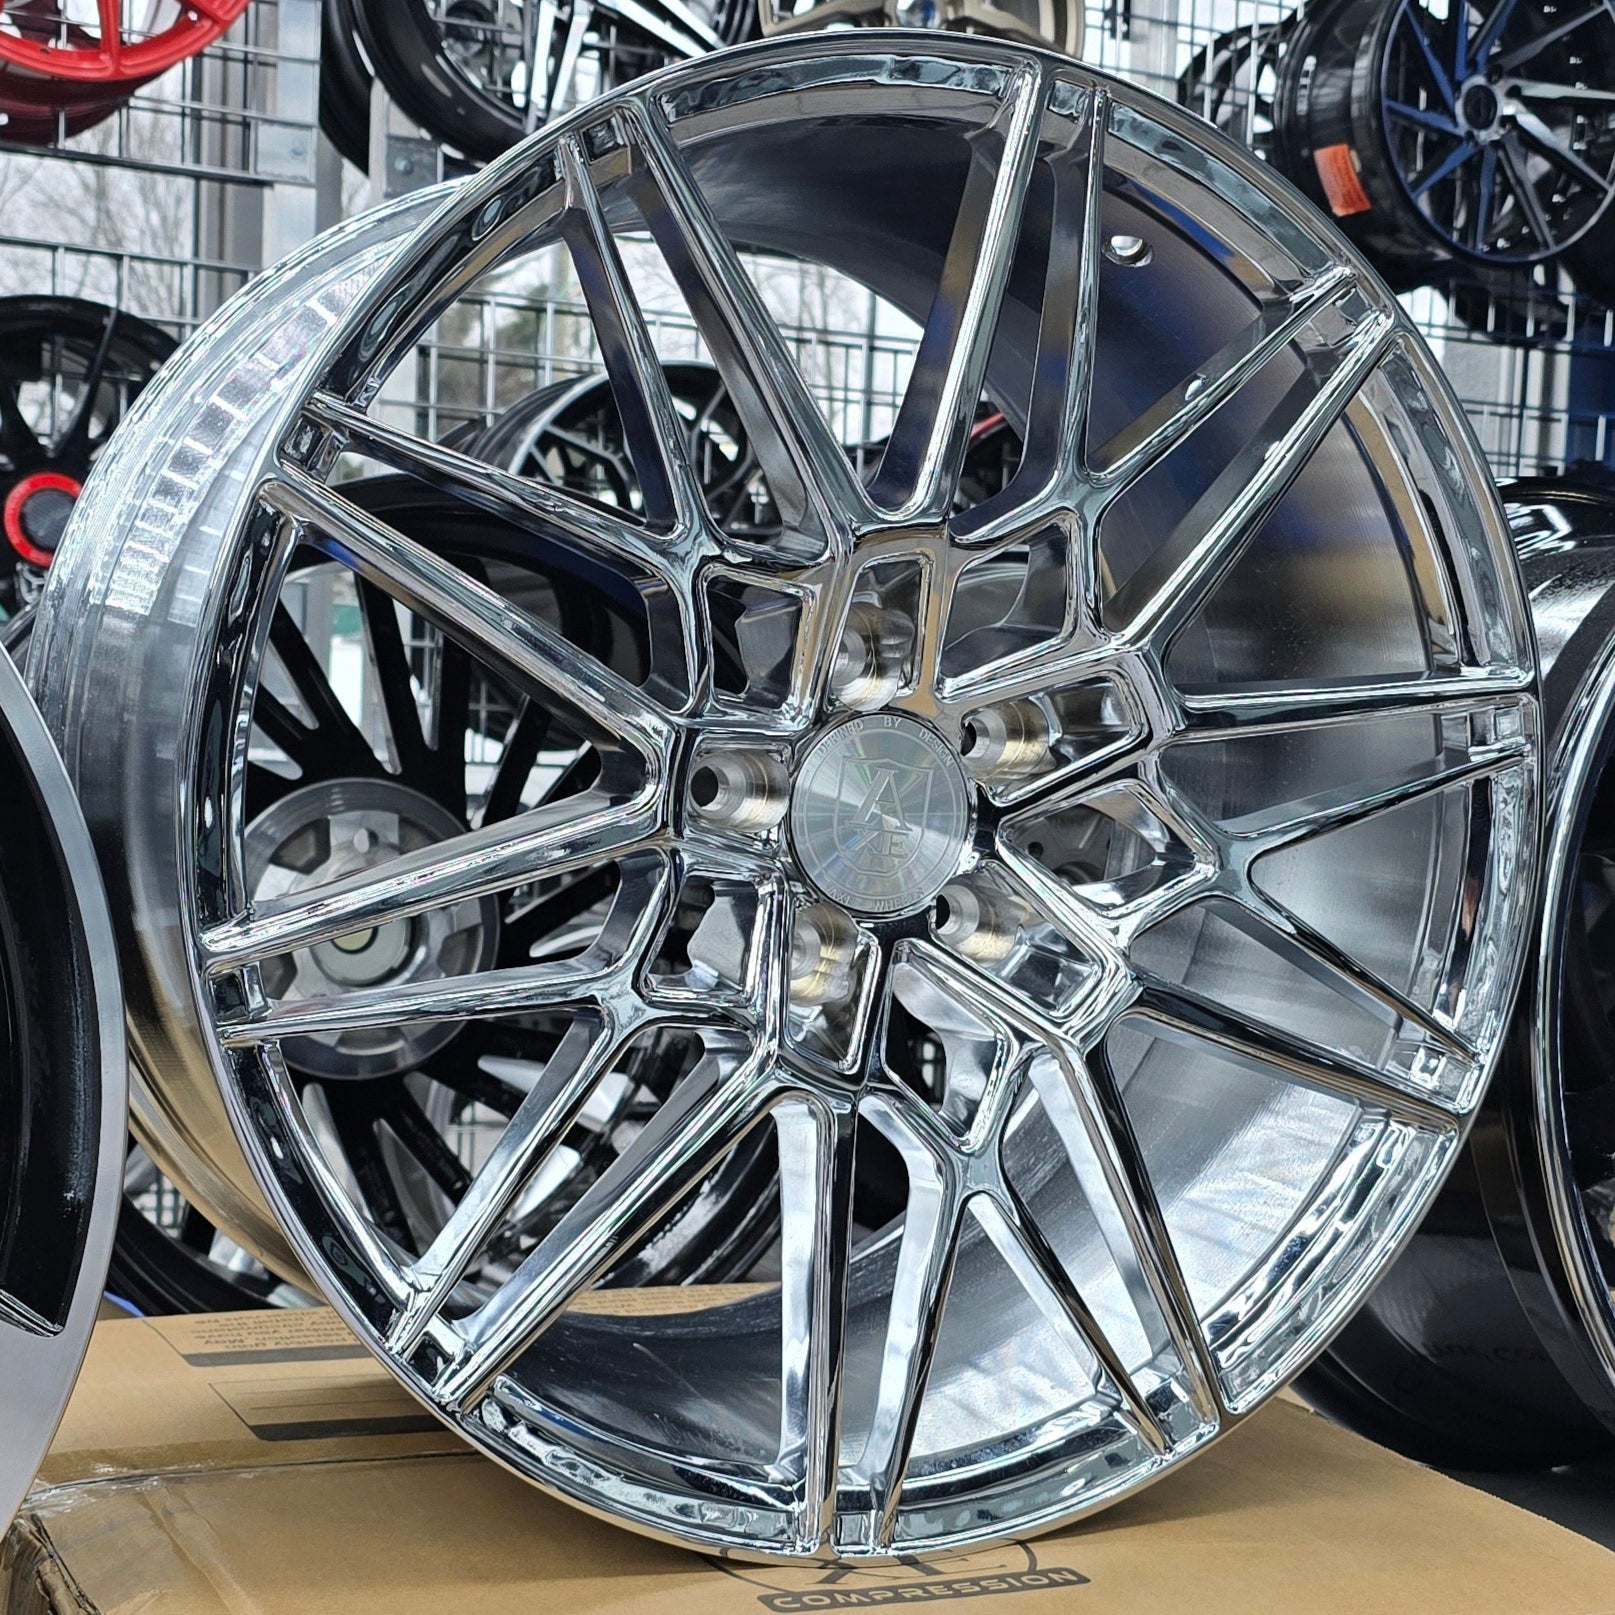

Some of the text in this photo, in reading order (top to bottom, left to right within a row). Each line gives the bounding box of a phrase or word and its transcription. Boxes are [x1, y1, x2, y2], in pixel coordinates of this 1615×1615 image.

[883, 716, 901, 729] BY
[918, 728, 955, 768] DESIGN
[772, 1570, 1081, 1609] COMPRESSION
